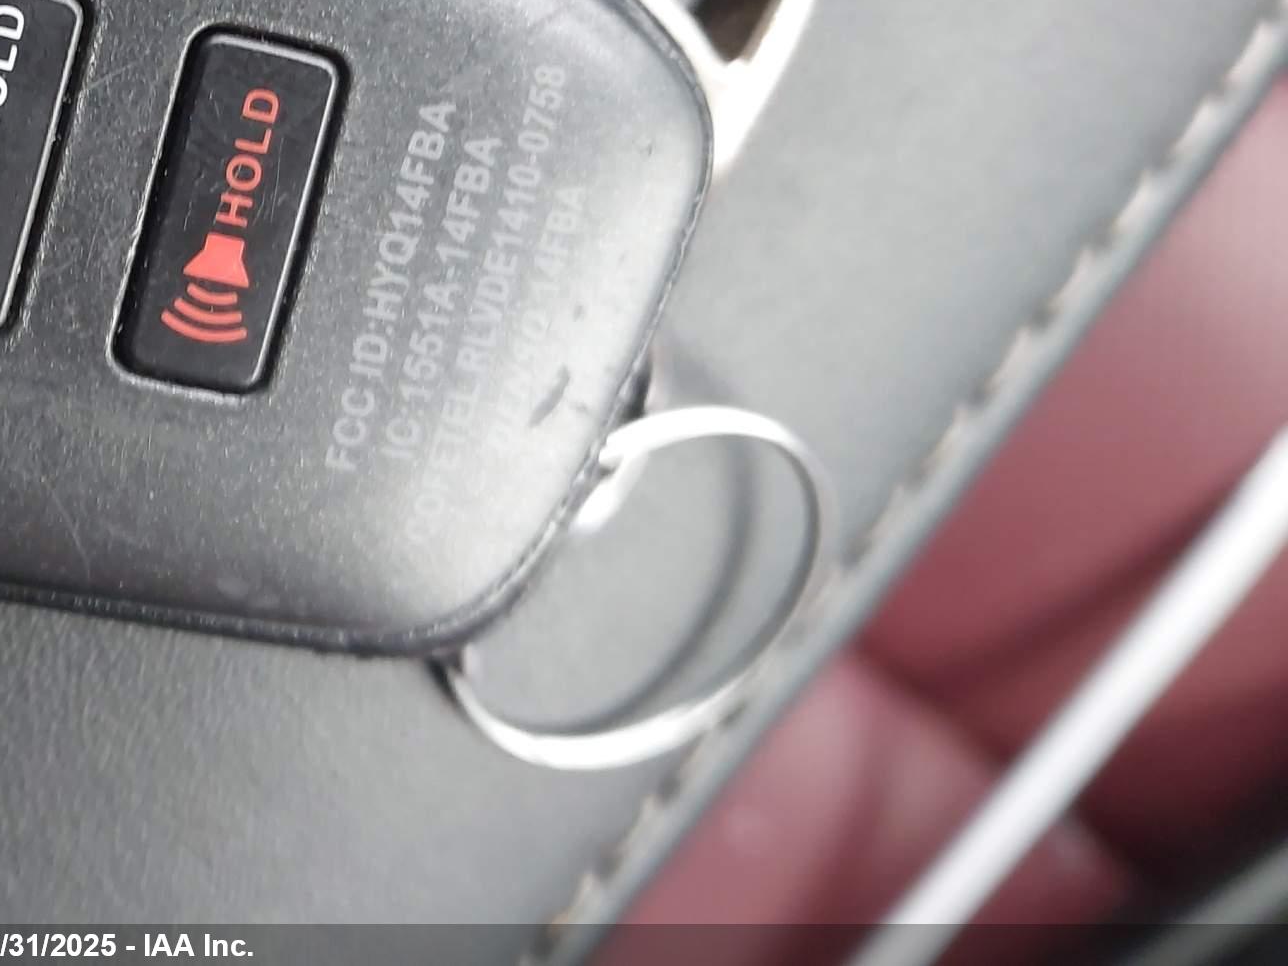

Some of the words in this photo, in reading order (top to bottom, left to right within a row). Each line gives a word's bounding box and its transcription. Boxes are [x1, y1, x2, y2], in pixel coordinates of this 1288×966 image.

[215, 88, 281, 228] HOLD
[350, 100, 457, 380] ID:HYQ14FBA
[456, 63, 567, 374] RLVDE1410-0758
[531, 185, 587, 300] 14FBA
[381, 135, 503, 461] IC:1551A-14FBA
[325, 385, 376, 472] FCC
